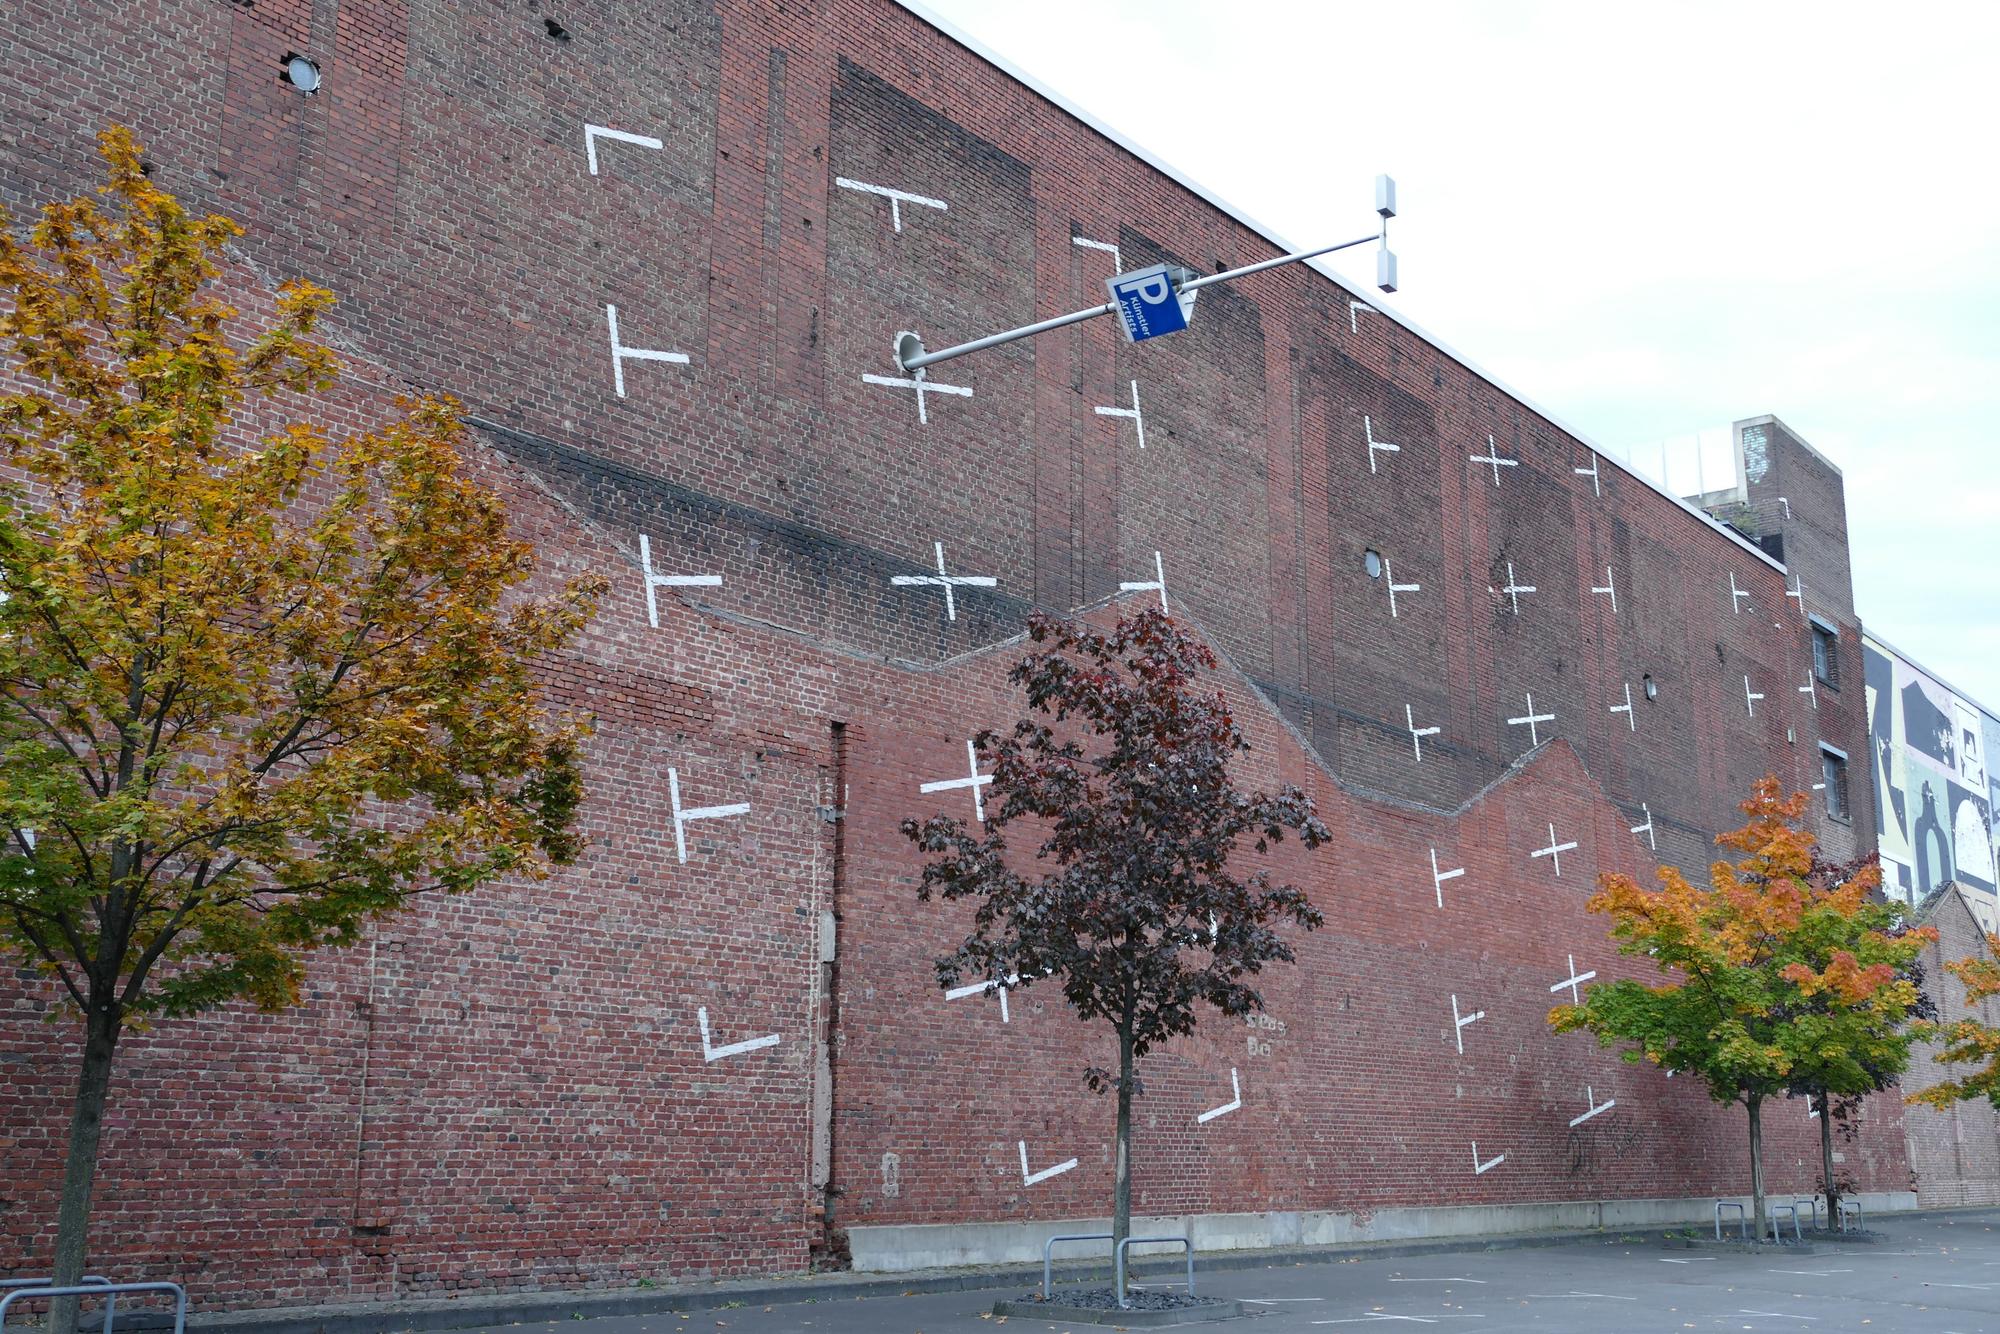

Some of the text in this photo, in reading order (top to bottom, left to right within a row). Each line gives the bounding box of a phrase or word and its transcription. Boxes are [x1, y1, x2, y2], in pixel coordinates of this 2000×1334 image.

[1119, 274, 1169, 305] P
[1120, 300, 1138, 333] Artists
[1130, 296, 1151, 336] Künstler
